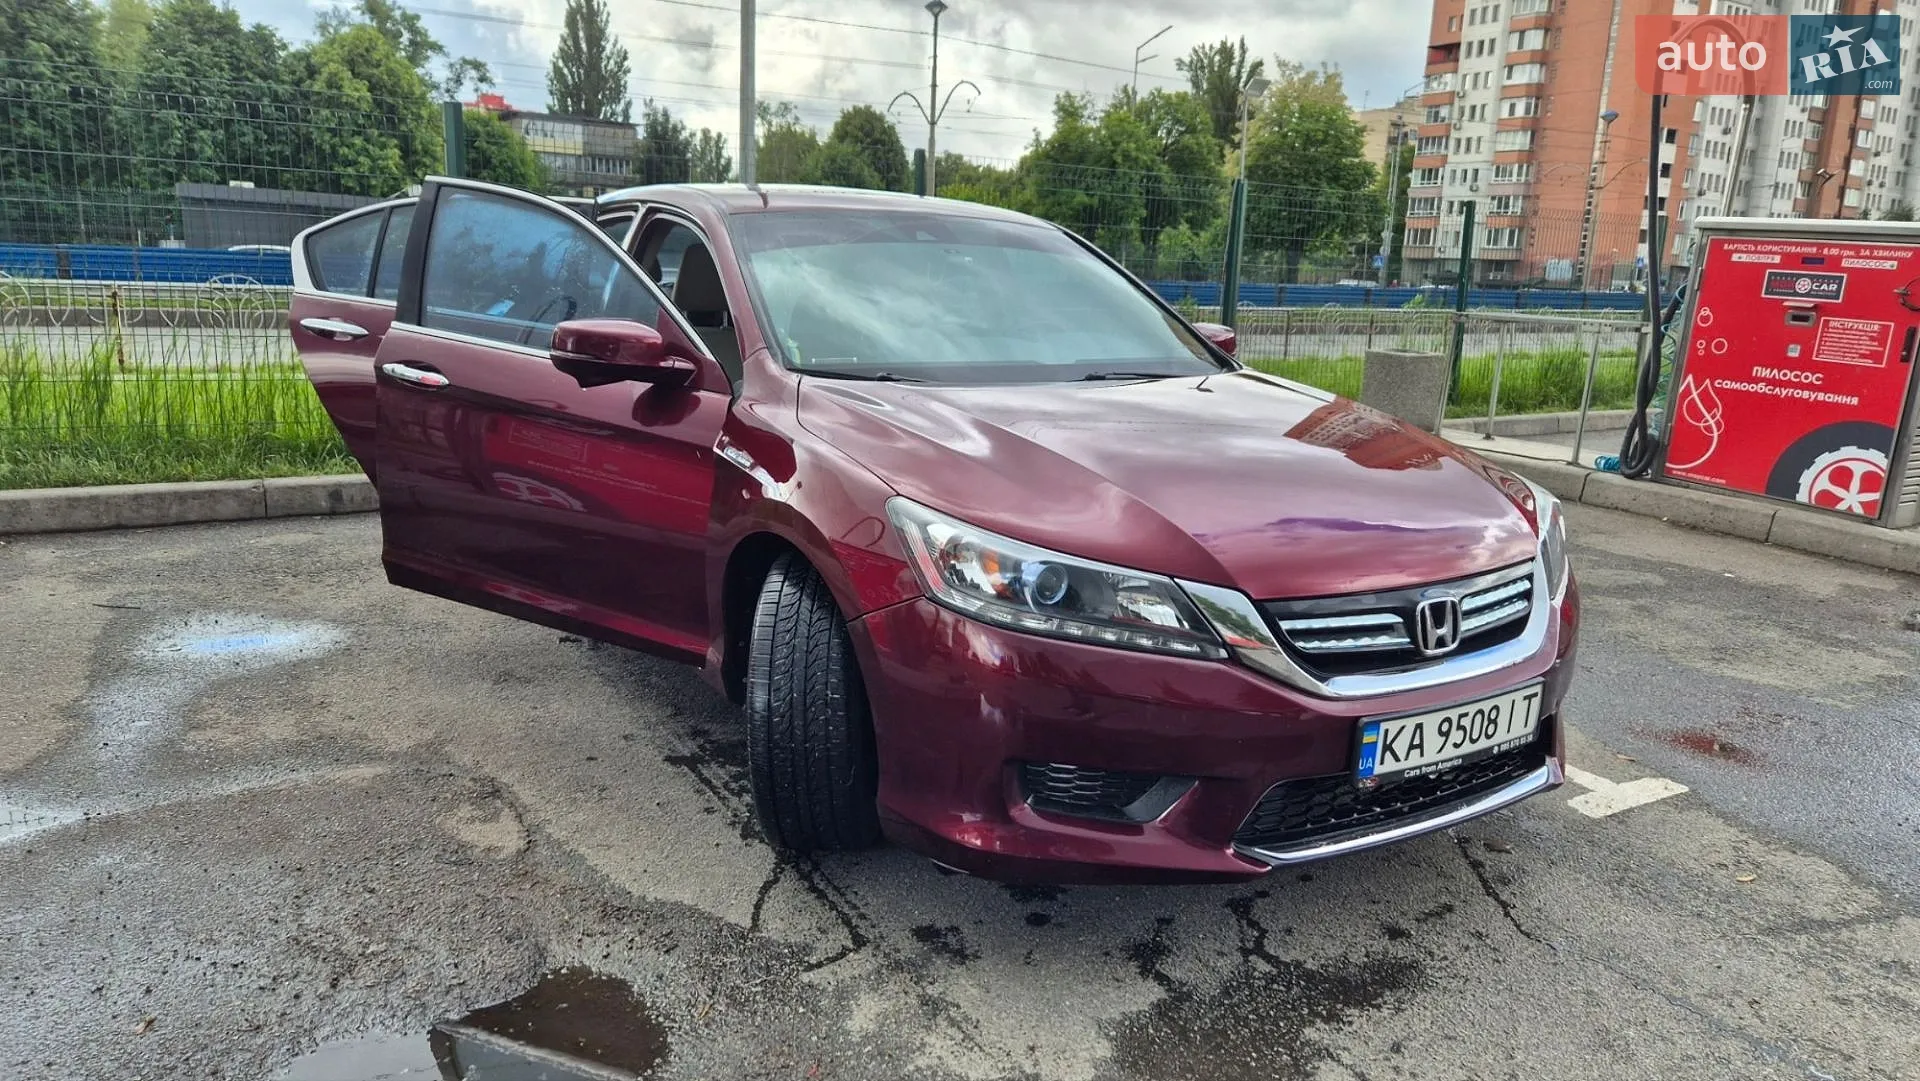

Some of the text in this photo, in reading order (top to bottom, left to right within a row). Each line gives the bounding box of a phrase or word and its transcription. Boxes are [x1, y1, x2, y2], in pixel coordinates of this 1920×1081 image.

[1872, 250, 1914, 259] ХВИЛИНУ
[1843, 259, 1889, 268] ПИЛОСОС
[1812, 282, 1838, 291] CAR
[1752, 366, 1824, 385] ПИЛОСОС
[1714, 378, 1859, 406] самообслуговування
[1379, 692, 1539, 766] KA 9508 IT
[1359, 758, 1373, 770] UA
[1404, 758, 1462, 777] Cars from America
